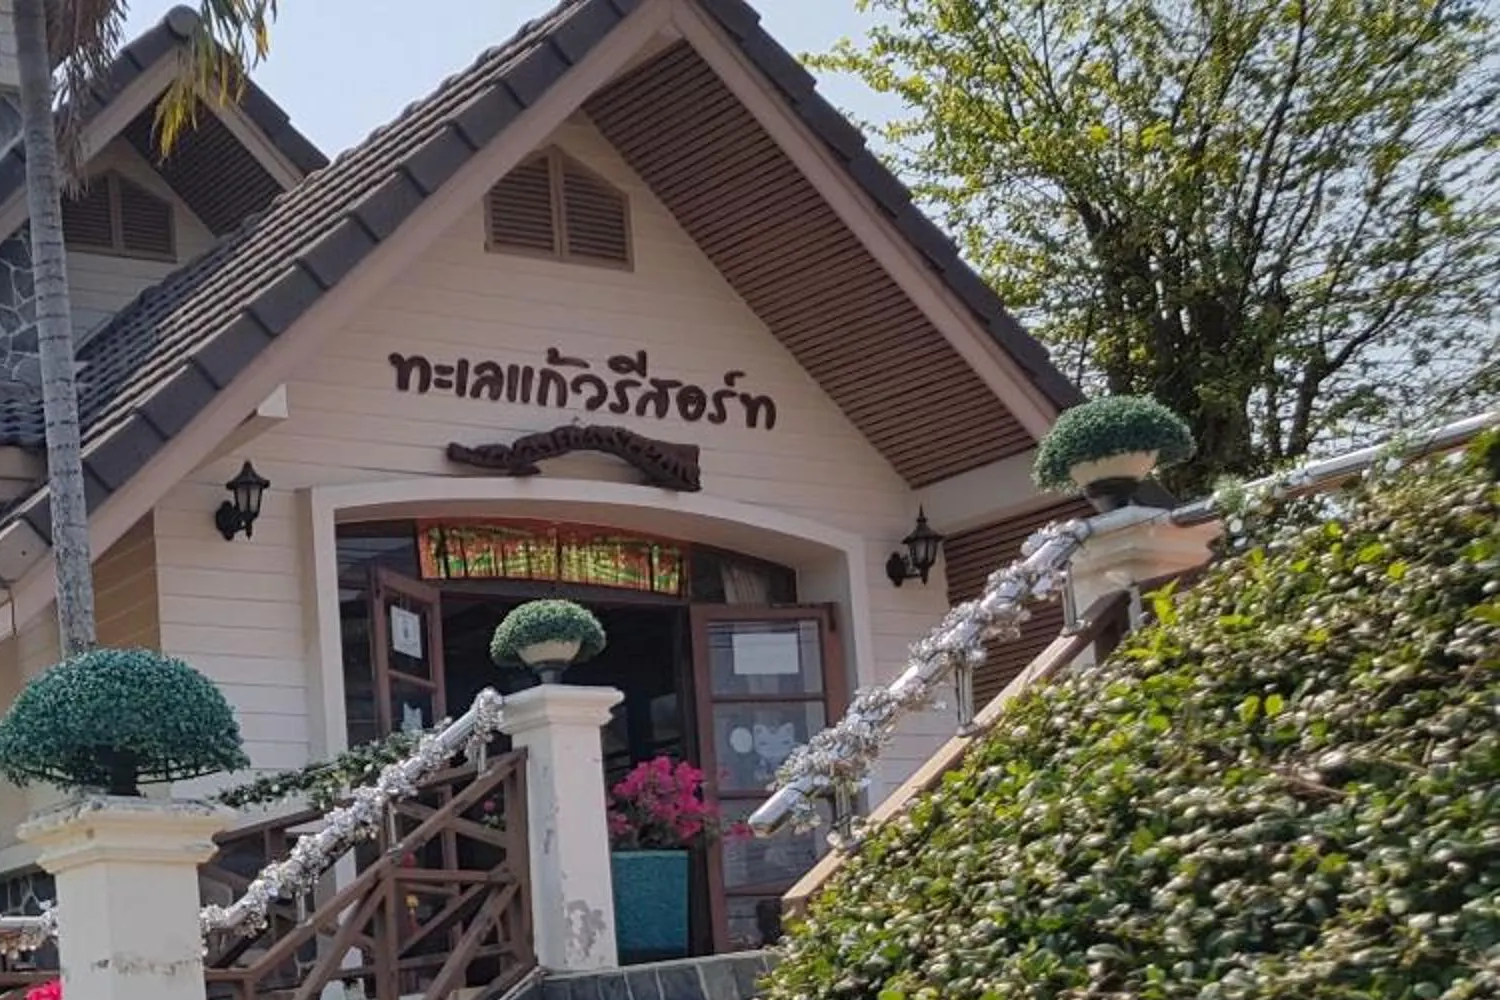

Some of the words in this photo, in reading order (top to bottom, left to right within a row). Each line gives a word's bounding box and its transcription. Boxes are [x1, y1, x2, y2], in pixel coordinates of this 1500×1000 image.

[387, 346, 777, 430] ทะเลแก้วรีสอร์ท
